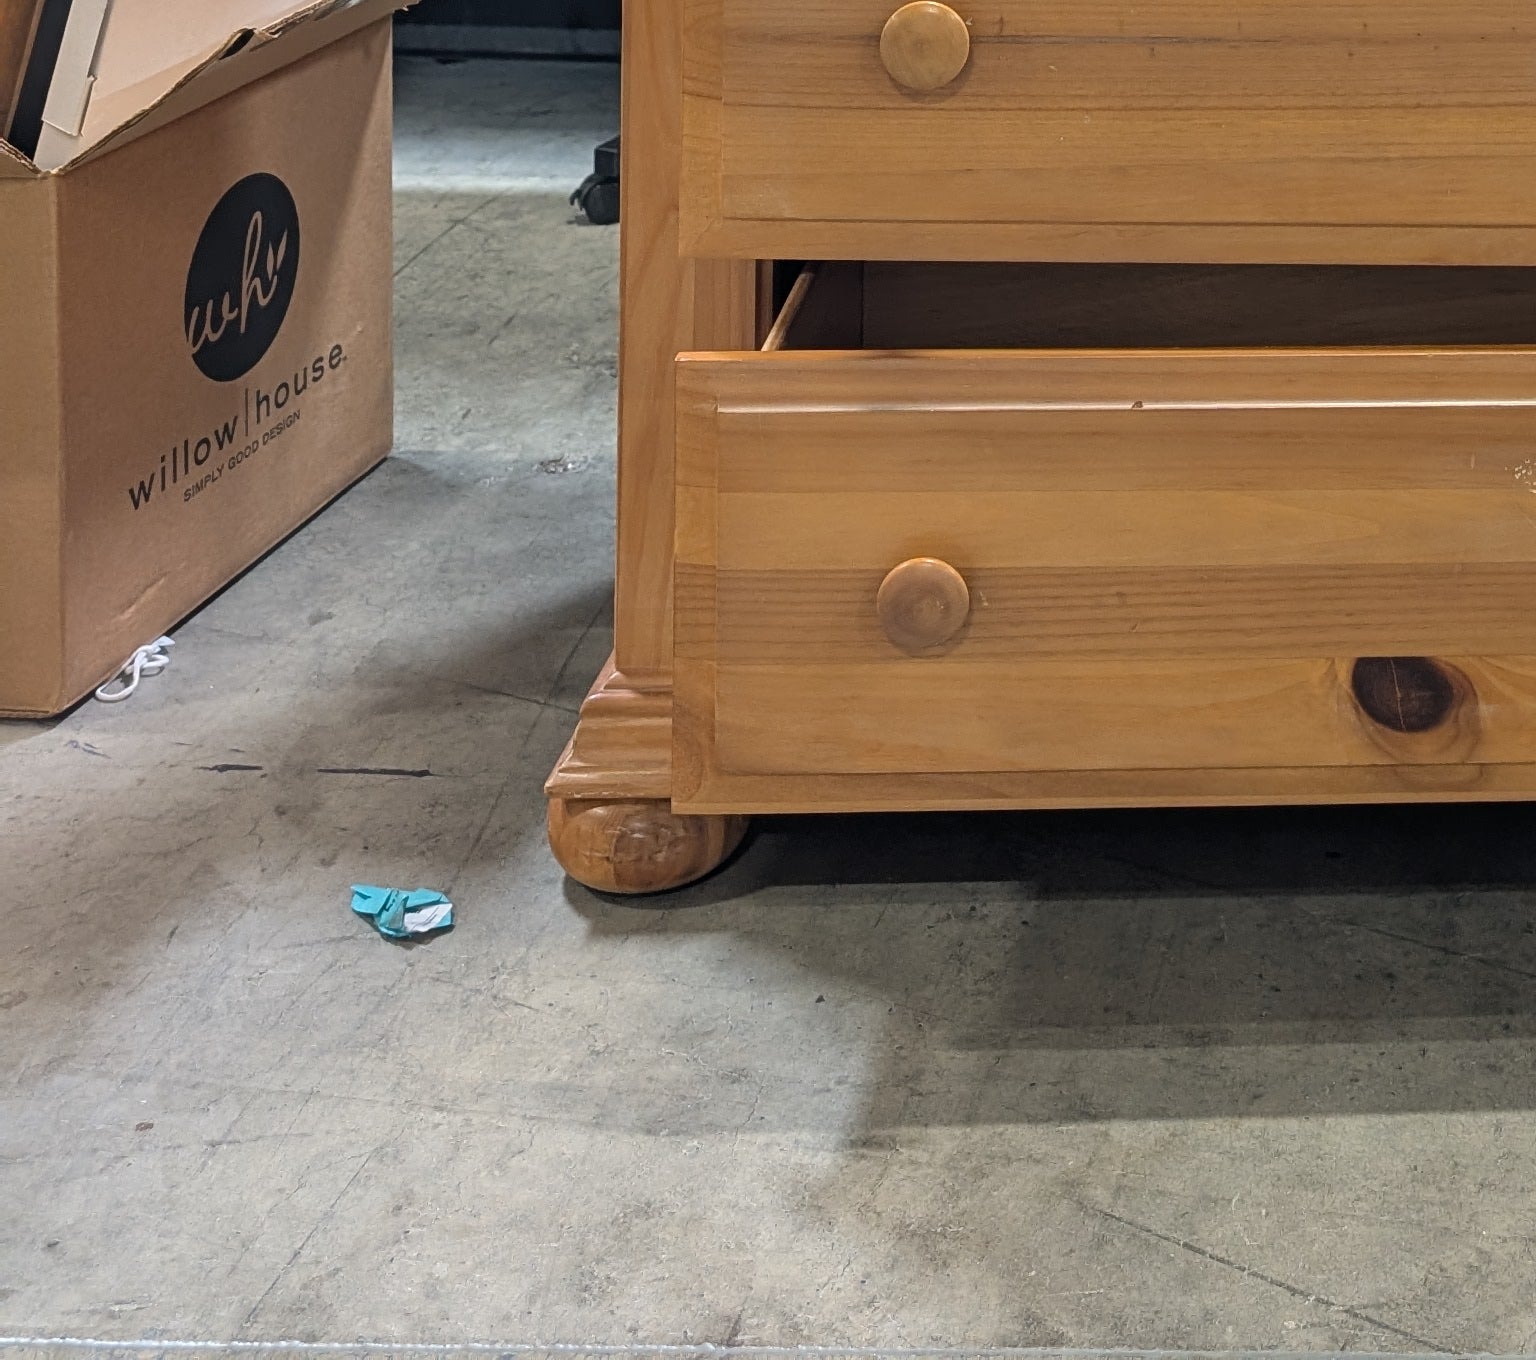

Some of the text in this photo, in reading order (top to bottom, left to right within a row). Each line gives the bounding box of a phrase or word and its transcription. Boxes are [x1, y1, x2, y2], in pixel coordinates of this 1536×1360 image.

[183, 409, 301, 502] SIMPLY GOOD DESIGN
